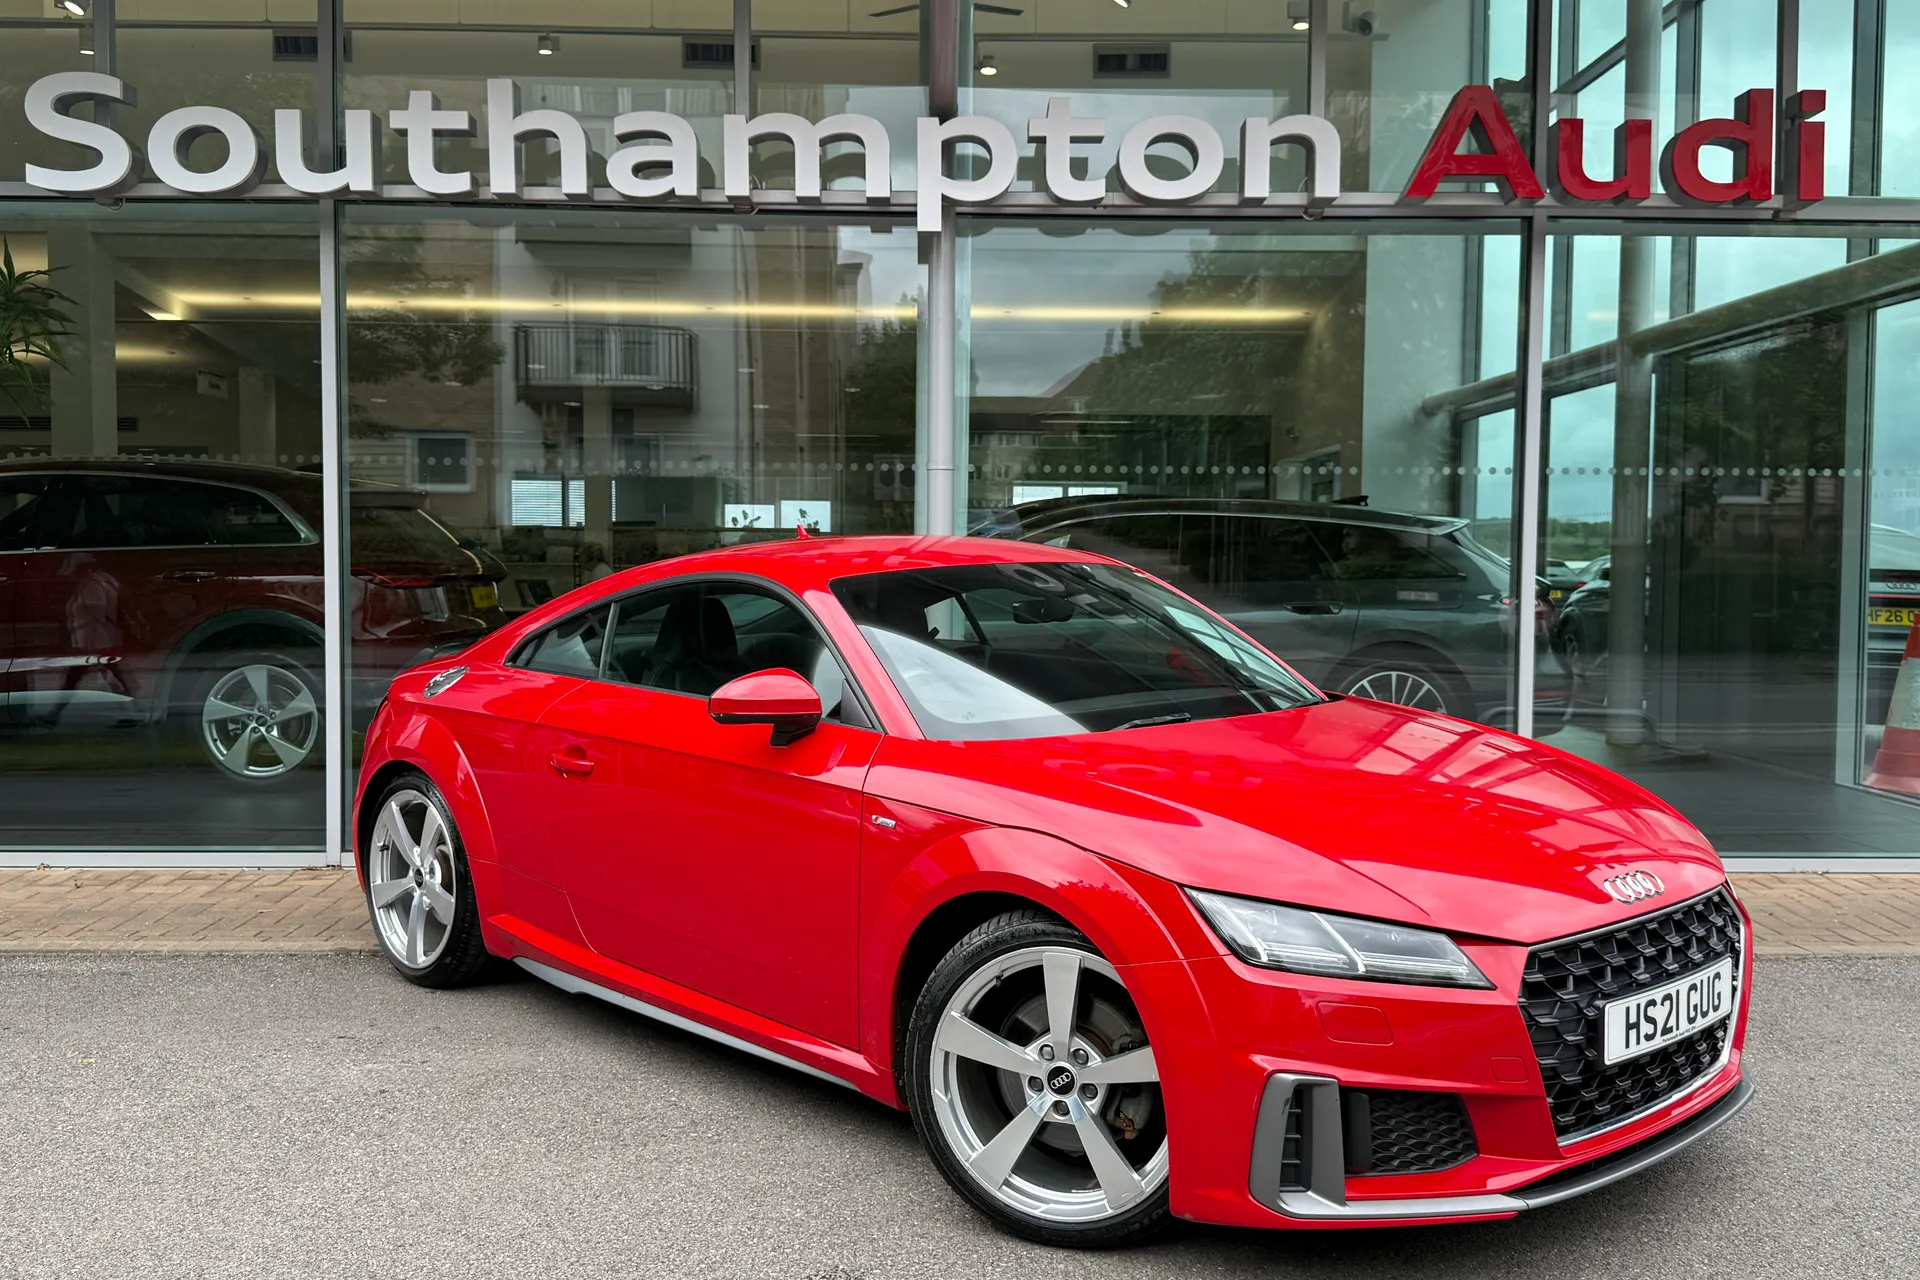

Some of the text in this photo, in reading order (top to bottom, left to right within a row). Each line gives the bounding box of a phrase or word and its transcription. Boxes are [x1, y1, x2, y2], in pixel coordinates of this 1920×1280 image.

[24, 71, 1827, 232] Southampton Audi
[1624, 971, 1722, 1049] HS21 GUG
